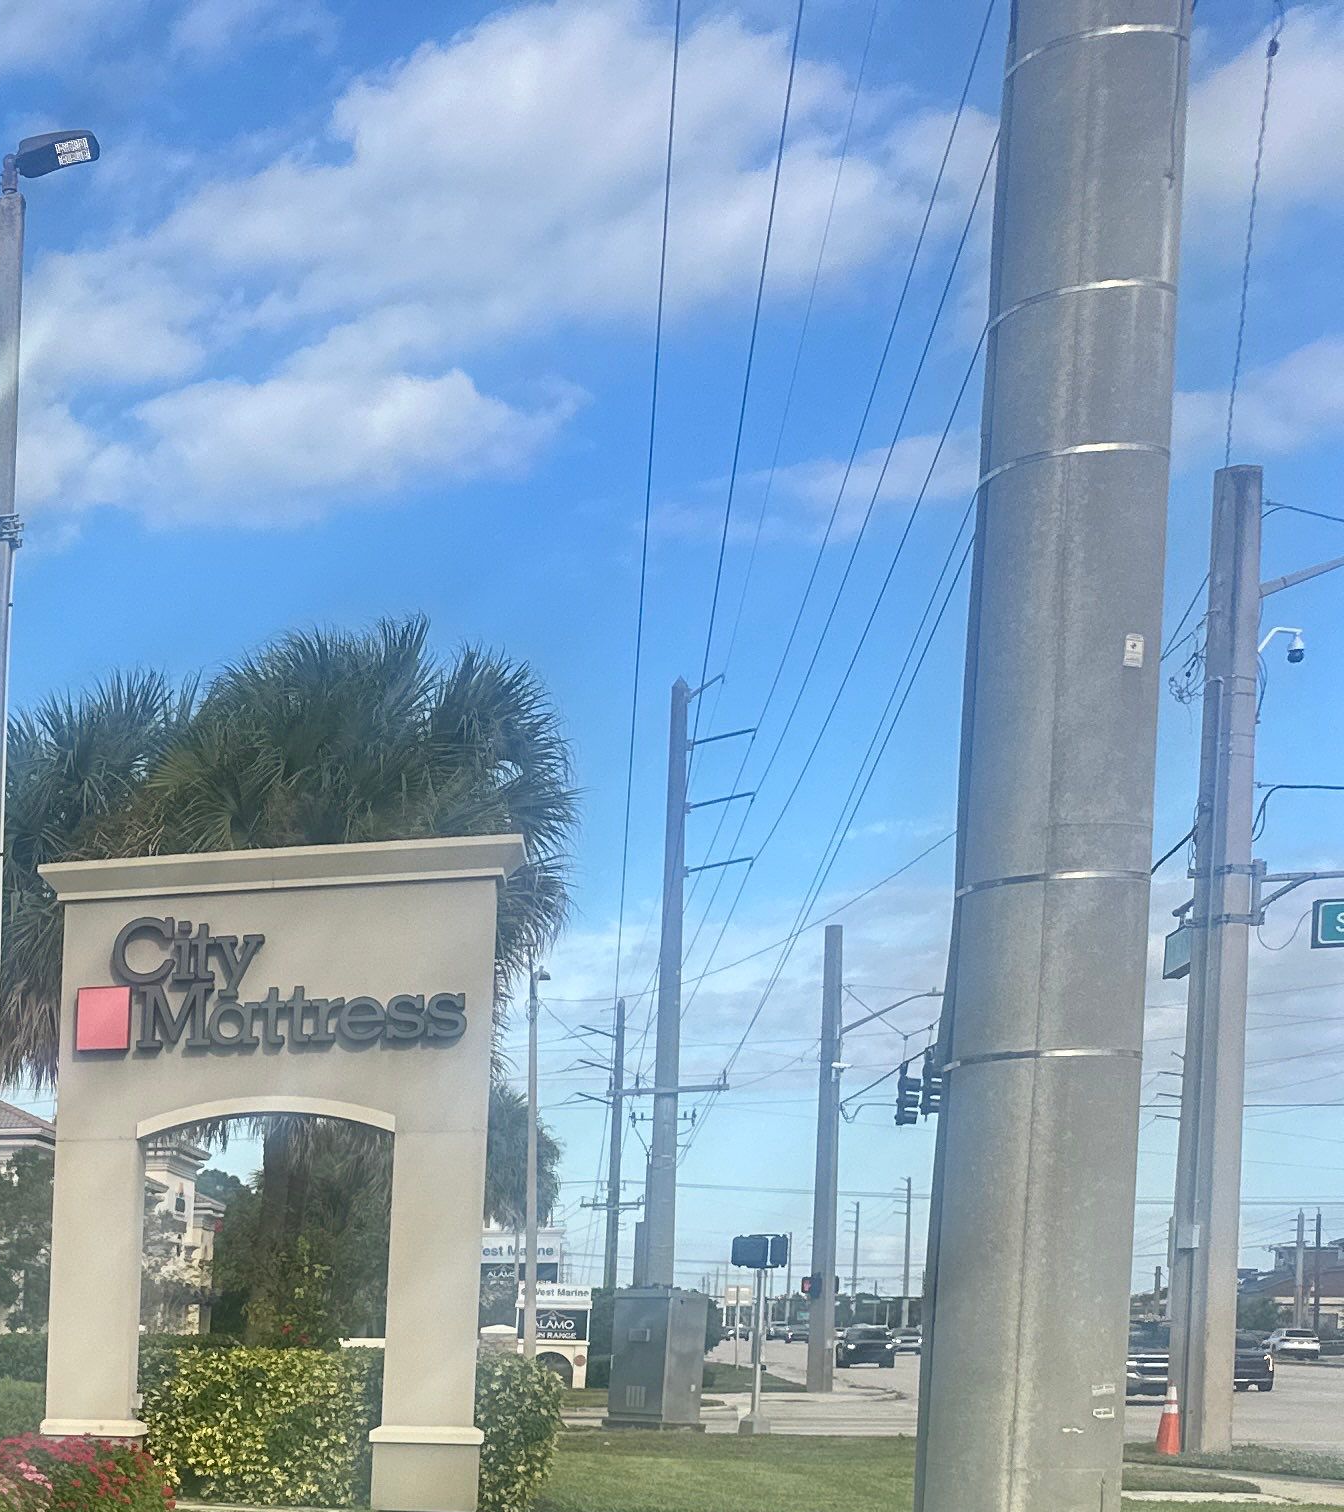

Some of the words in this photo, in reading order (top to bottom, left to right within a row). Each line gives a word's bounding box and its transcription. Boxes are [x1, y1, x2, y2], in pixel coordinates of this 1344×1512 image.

[112, 916, 265, 999] City
[134, 982, 467, 1053] Mattress
[482, 1246, 503, 1257] est
[508, 1245, 554, 1257] Mane
[557, 1288, 590, 1298] Marine
